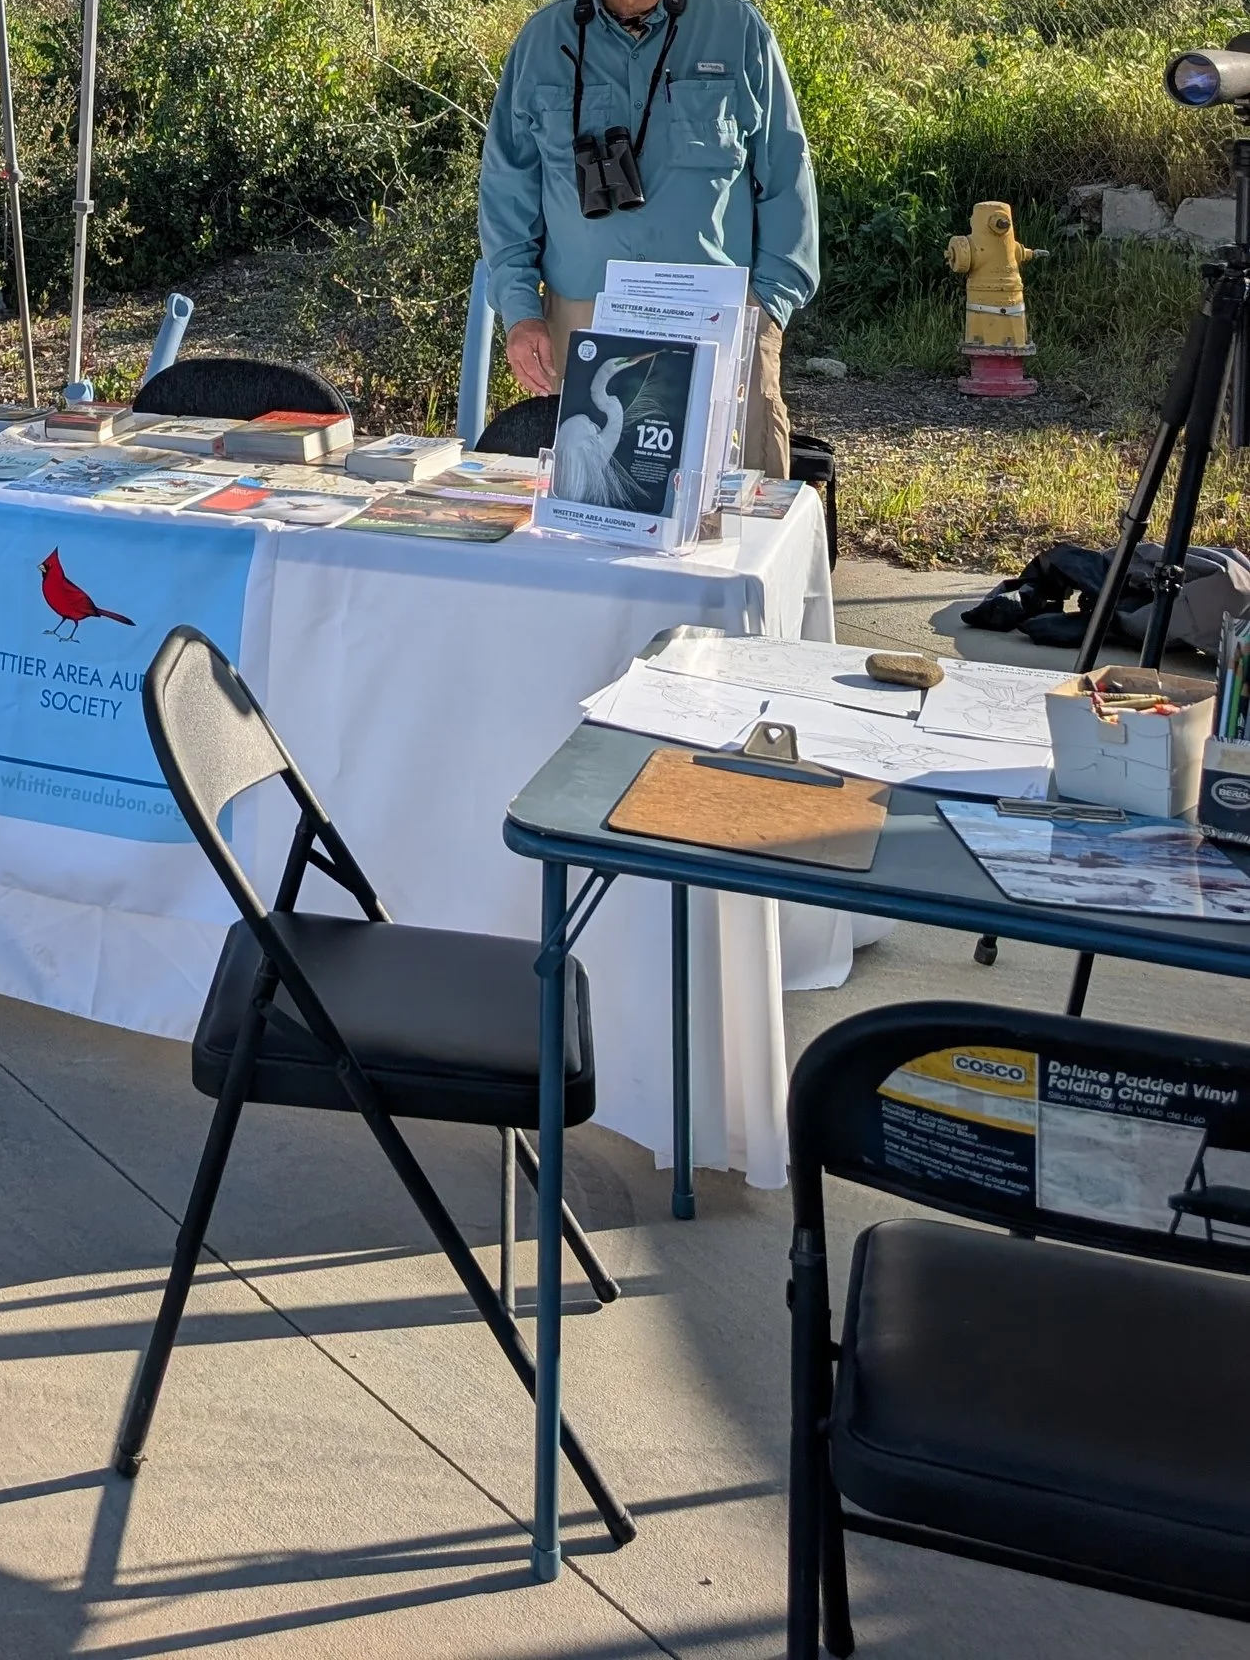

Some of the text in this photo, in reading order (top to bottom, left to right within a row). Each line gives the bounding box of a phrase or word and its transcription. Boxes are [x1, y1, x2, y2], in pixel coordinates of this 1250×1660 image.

[611, 303, 642, 311] WHITTIER
[662, 308, 694, 316] AUDUBON
[637, 425, 673, 451] 120
[553, 508, 584, 518] WHITTIER
[586, 513, 602, 522] AREA
[604, 517, 636, 528] AUDUBON
[52, 662, 102, 687] AREA
[40, 689, 122, 719] SOCIETY
[956, 1057, 1022, 1079] COSCO
[1048, 1061, 1109, 1082] Deluxe
[1115, 1072, 1186, 1095] Padded
[1192, 1084, 1238, 1104] Vinyl
[1048, 1075, 1113, 1099] Folding
[1118, 1087, 1168, 1106] Chair
